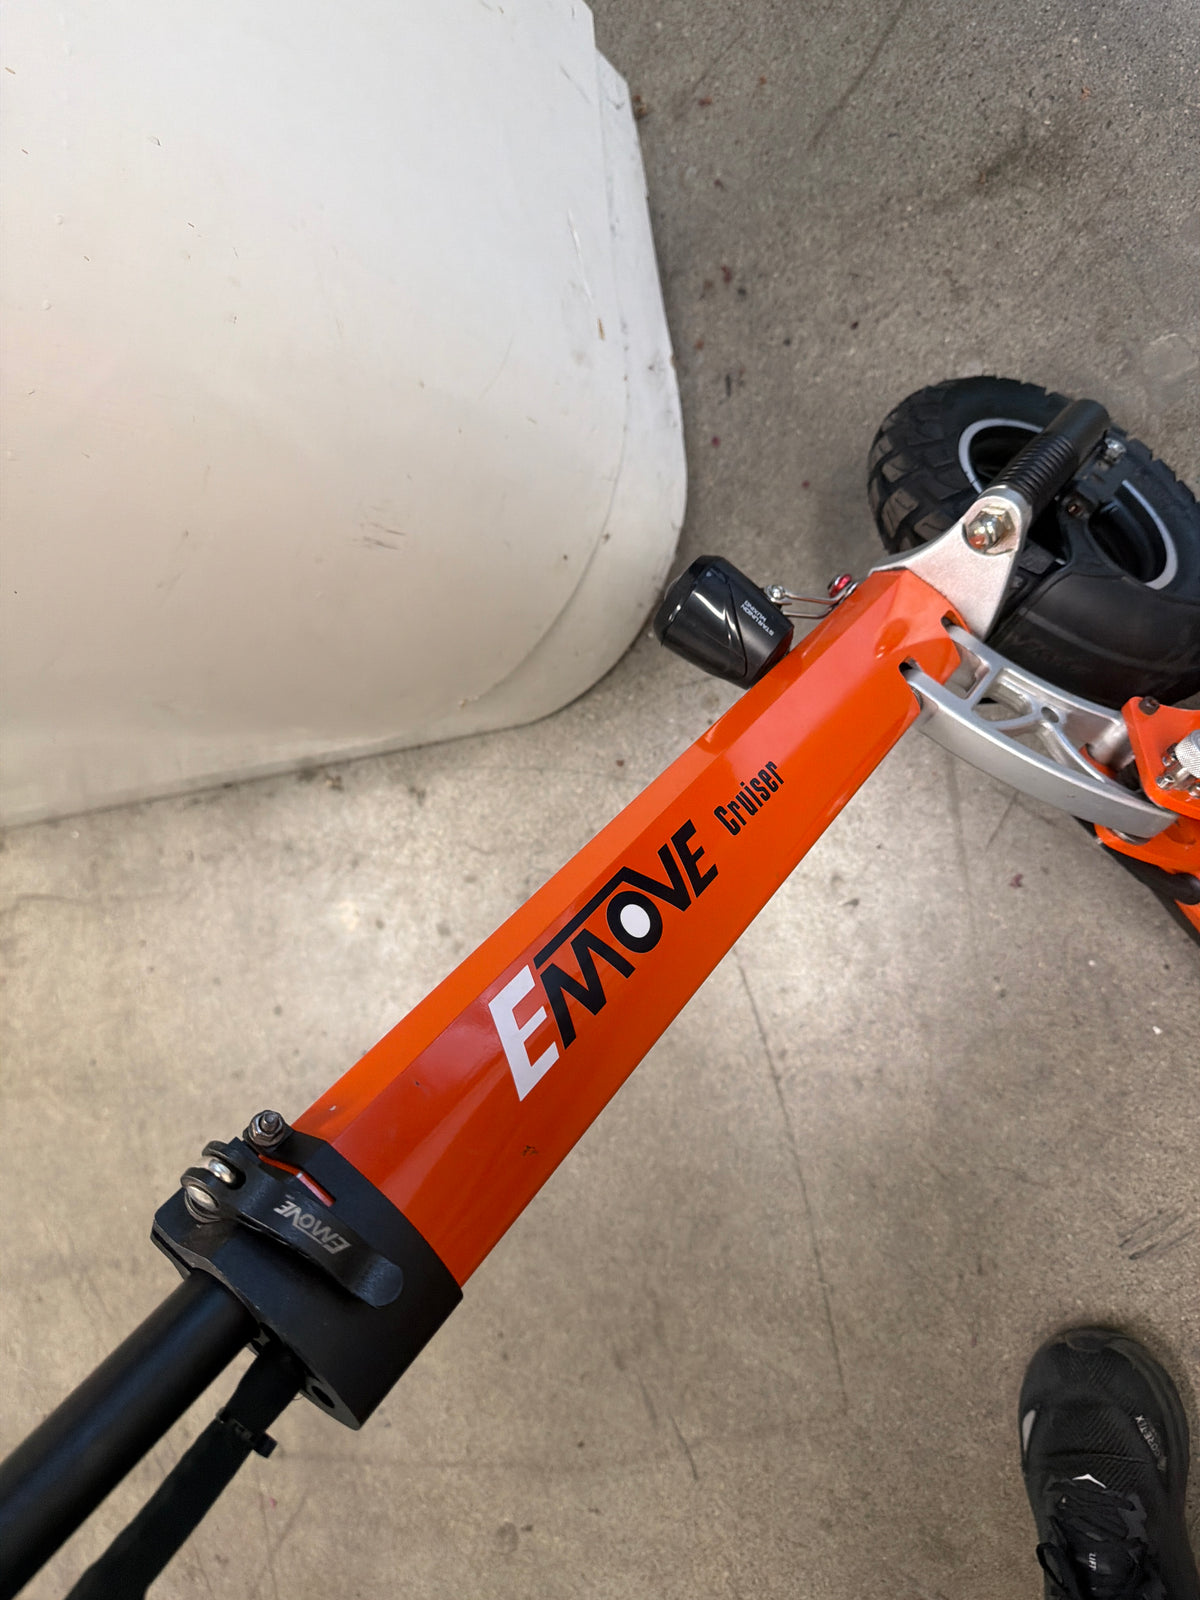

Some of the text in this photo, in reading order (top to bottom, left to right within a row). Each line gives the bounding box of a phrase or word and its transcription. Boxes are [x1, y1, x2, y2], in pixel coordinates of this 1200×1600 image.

[488, 761, 785, 1102] EMOVE Cruiser
[273, 1200, 351, 1254] EMOVE
